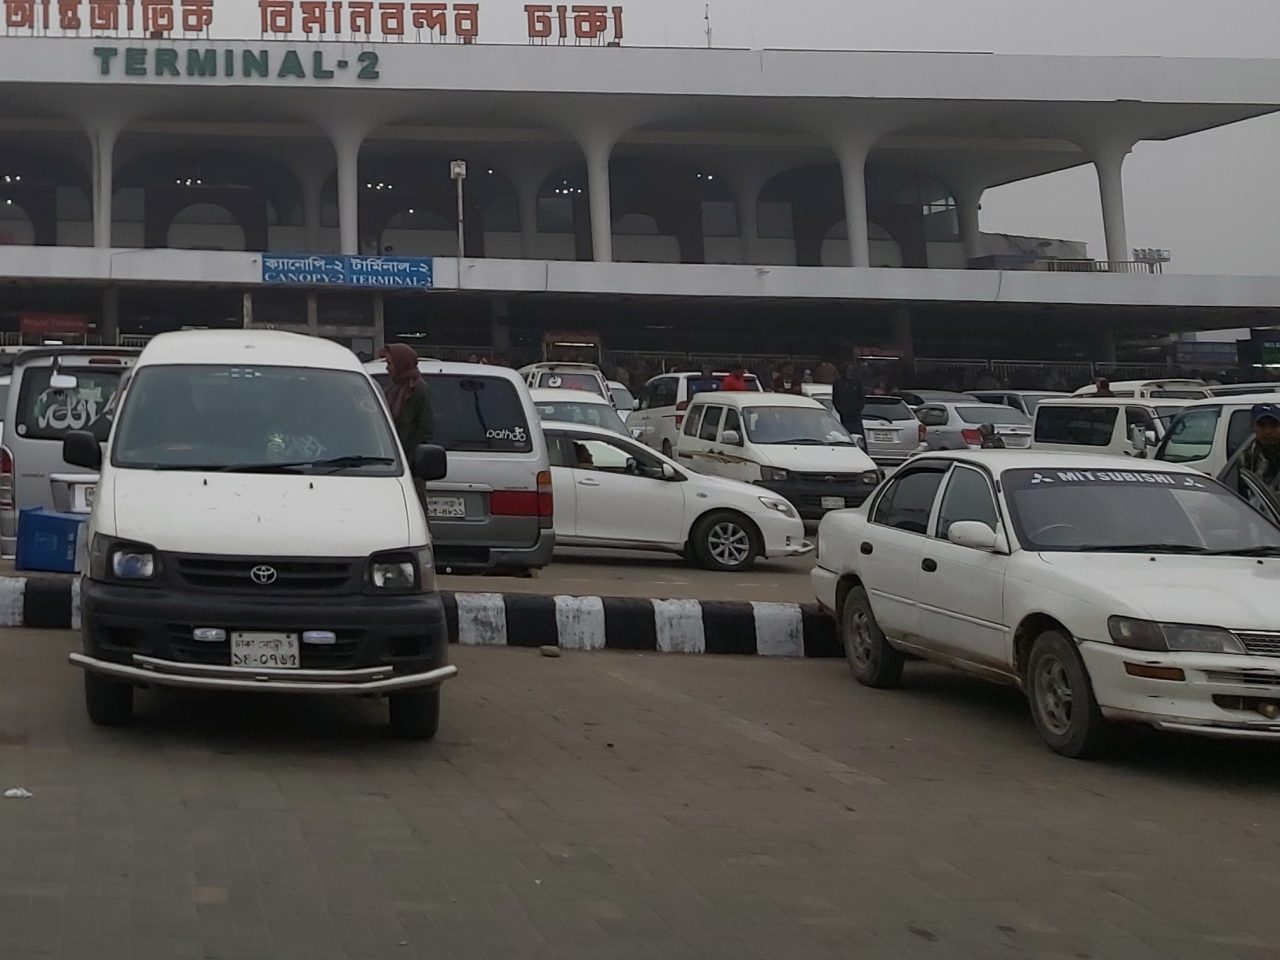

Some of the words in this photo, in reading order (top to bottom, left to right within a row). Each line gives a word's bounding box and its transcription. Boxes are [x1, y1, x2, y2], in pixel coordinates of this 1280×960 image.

[524, 4, 624, 40] ঢাকা
[93, 47, 381, 80] TERMINAL-2
[264, 272, 344, 283] CANOPY-2
[351, 275, 432, 286] TERMINAL-2
[486, 427, 527, 442] pathao
[1057, 471, 1175, 484] MITSUBISHI
